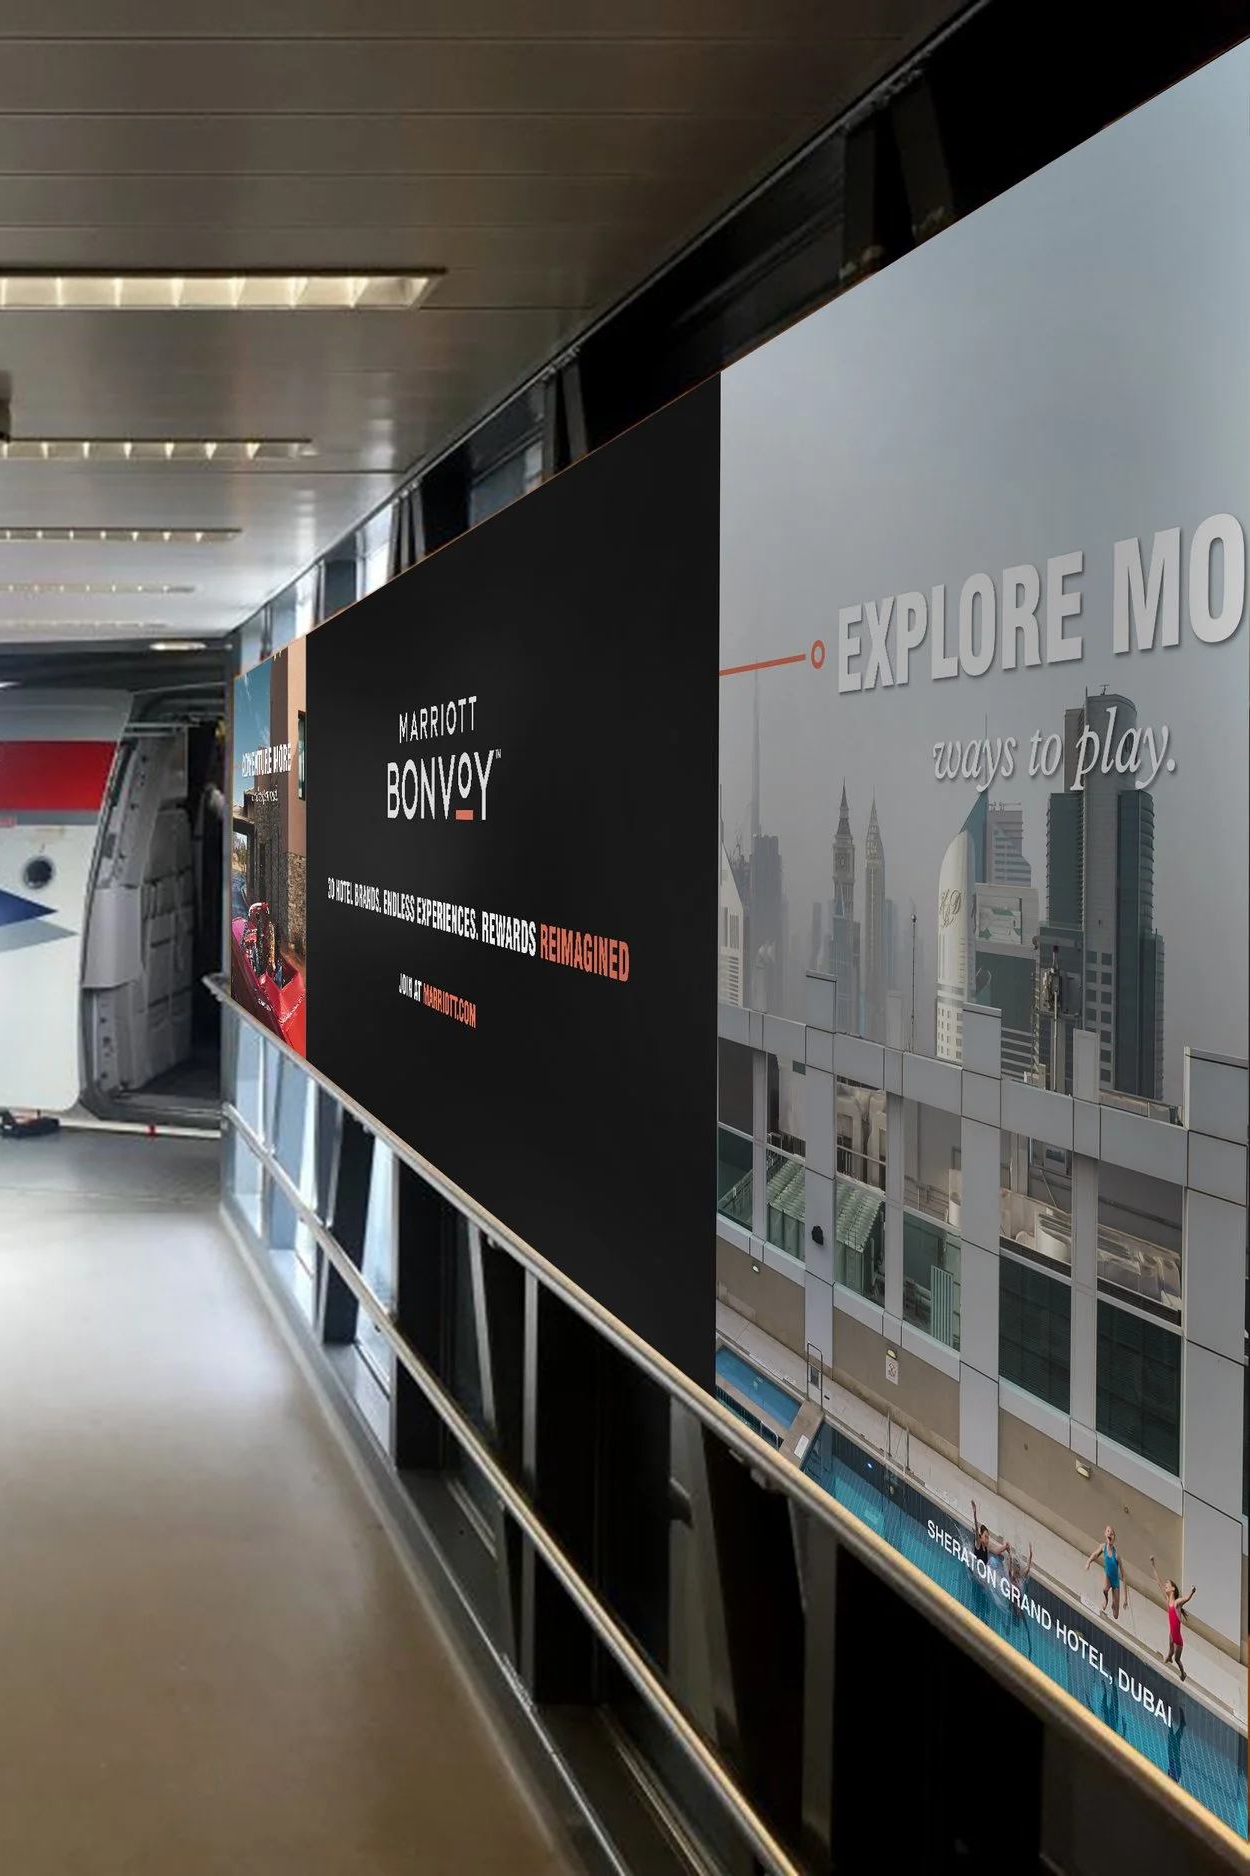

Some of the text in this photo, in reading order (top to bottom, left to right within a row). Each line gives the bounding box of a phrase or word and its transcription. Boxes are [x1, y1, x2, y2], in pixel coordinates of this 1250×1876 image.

[838, 512, 1245, 694] EXPLORE MO
[273, 743, 291, 773] MORE
[399, 696, 477, 743] MARRIOTT
[932, 706, 1177, 793] ways to play.
[327, 877, 630, 982] 30 HOTEL BRANDS. ENDLESS EXPERIENCES. REWARDS REIMAGINED
[399, 972, 477, 1028] JOIN AT MARRIOTT.COM
[927, 1519, 1172, 1728] SHERATON GRAND HOTEL, DUBAI
